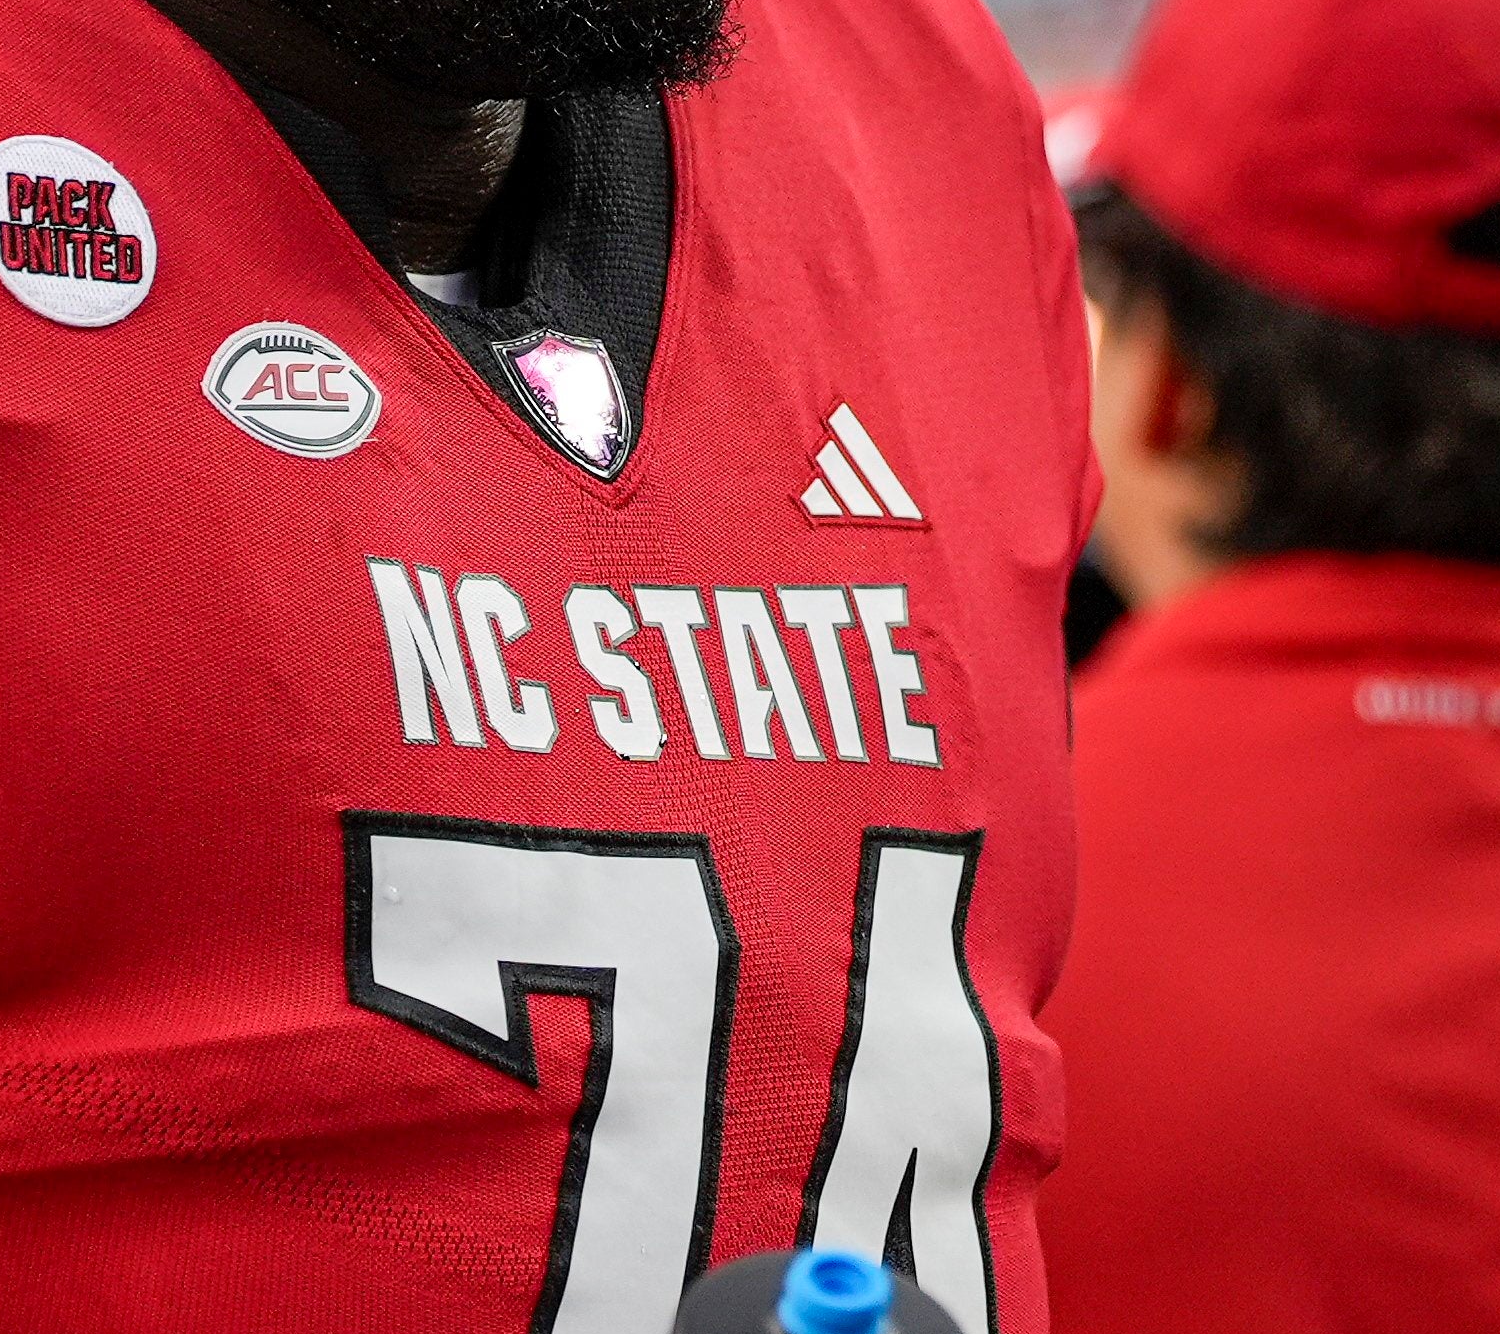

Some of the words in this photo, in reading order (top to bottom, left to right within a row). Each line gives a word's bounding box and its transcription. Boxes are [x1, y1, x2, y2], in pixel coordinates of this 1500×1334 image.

[7, 173, 116, 229] PACK
[0, 221, 143, 284] UNITED
[243, 362, 350, 402] ACC
[365, 554, 559, 754] NC
[562, 582, 943, 768] STATE
